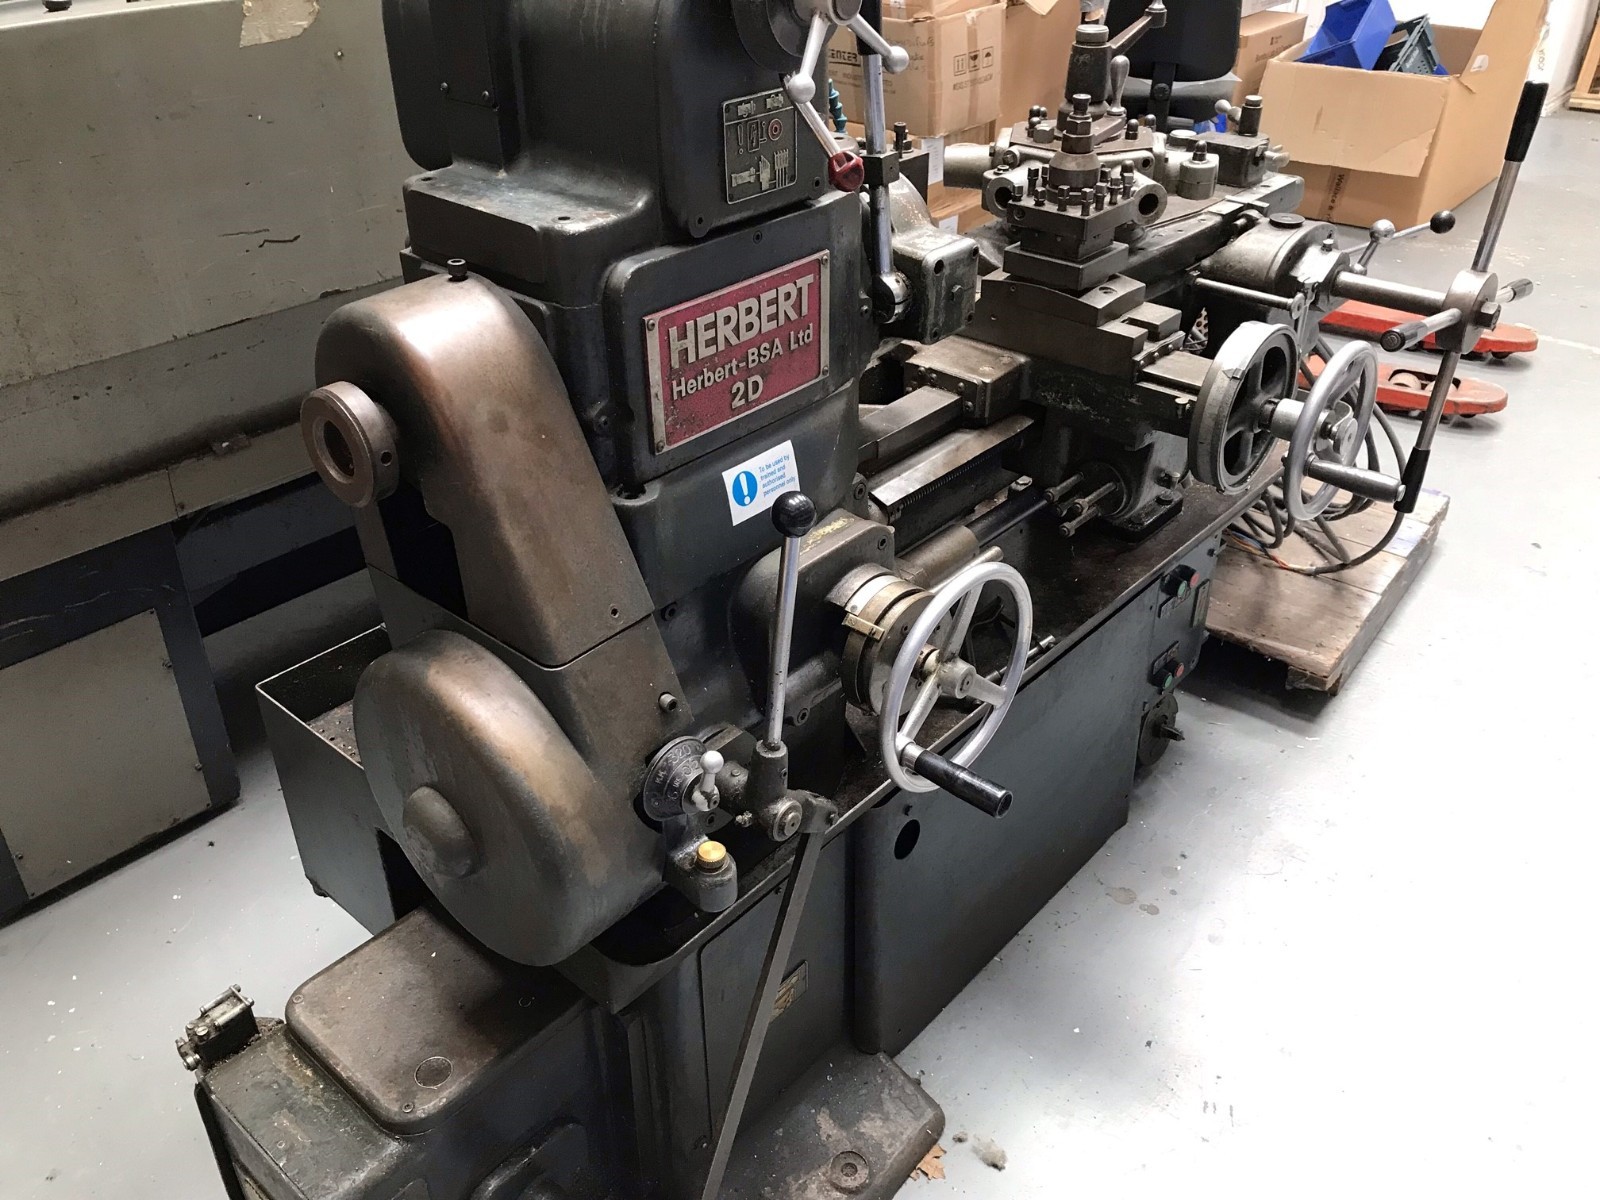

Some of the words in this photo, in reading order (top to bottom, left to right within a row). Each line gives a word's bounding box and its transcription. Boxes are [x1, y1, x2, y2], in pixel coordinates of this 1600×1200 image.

[668, 274, 814, 369] HERBERT
[672, 337, 783, 400] Herbert-BSA
[790, 323, 813, 351] Ltd
[731, 374, 764, 410] 2D
[772, 457, 783, 466] used
[760, 470, 776, 480] trained
[762, 472, 786, 488] authorised
[763, 482, 786, 497] personnel
[786, 476, 796, 484] only
